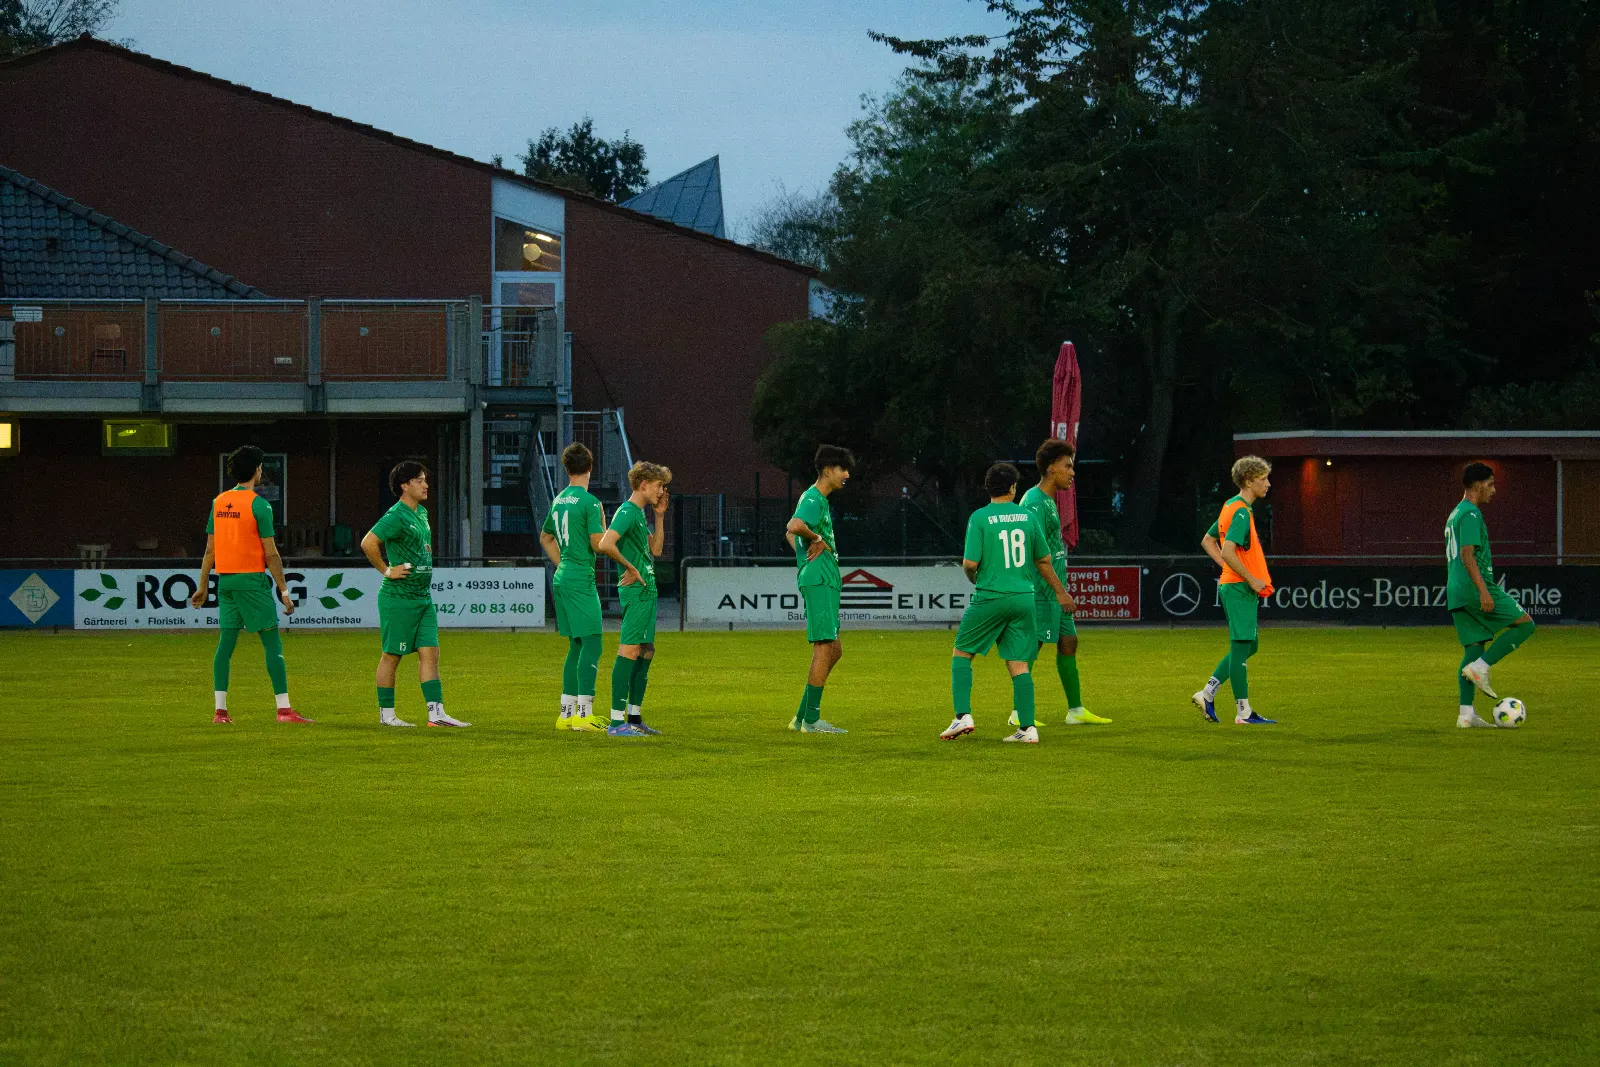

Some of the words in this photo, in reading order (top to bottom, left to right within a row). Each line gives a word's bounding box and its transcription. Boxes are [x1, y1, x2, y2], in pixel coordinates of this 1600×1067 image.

[552, 510, 569, 547] 14
[999, 528, 1026, 569] 18
[1066, 572, 1100, 581] rgweg
[1103, 570, 1108, 579] 1
[136, 573, 308, 609] ROBG
[430, 582, 445, 591] eg
[446, 580, 454, 590] 3
[465, 580, 500, 590] 49393
[503, 580, 534, 590] Lohne
[1066, 583, 1077, 592] 93
[1080, 583, 1115, 592] Lohne
[717, 593, 806, 609] ANTO
[898, 593, 974, 609] EIKE
[1074, 595, 1129, 605] 42-802300
[470, 603, 486, 614] 80
[490, 603, 506, 614] 83
[510, 603, 534, 614] 460
[1075, 608, 1131, 617] en-bau.de
[1523, 604, 1561, 615] nke.eu
[83, 616, 128, 626] Gärtnerei
[148, 616, 186, 626] Floristik
[289, 615, 361, 625] Landschaftsbau
[1046, 629, 1051, 640] 5
[399, 642, 407, 652] 15
